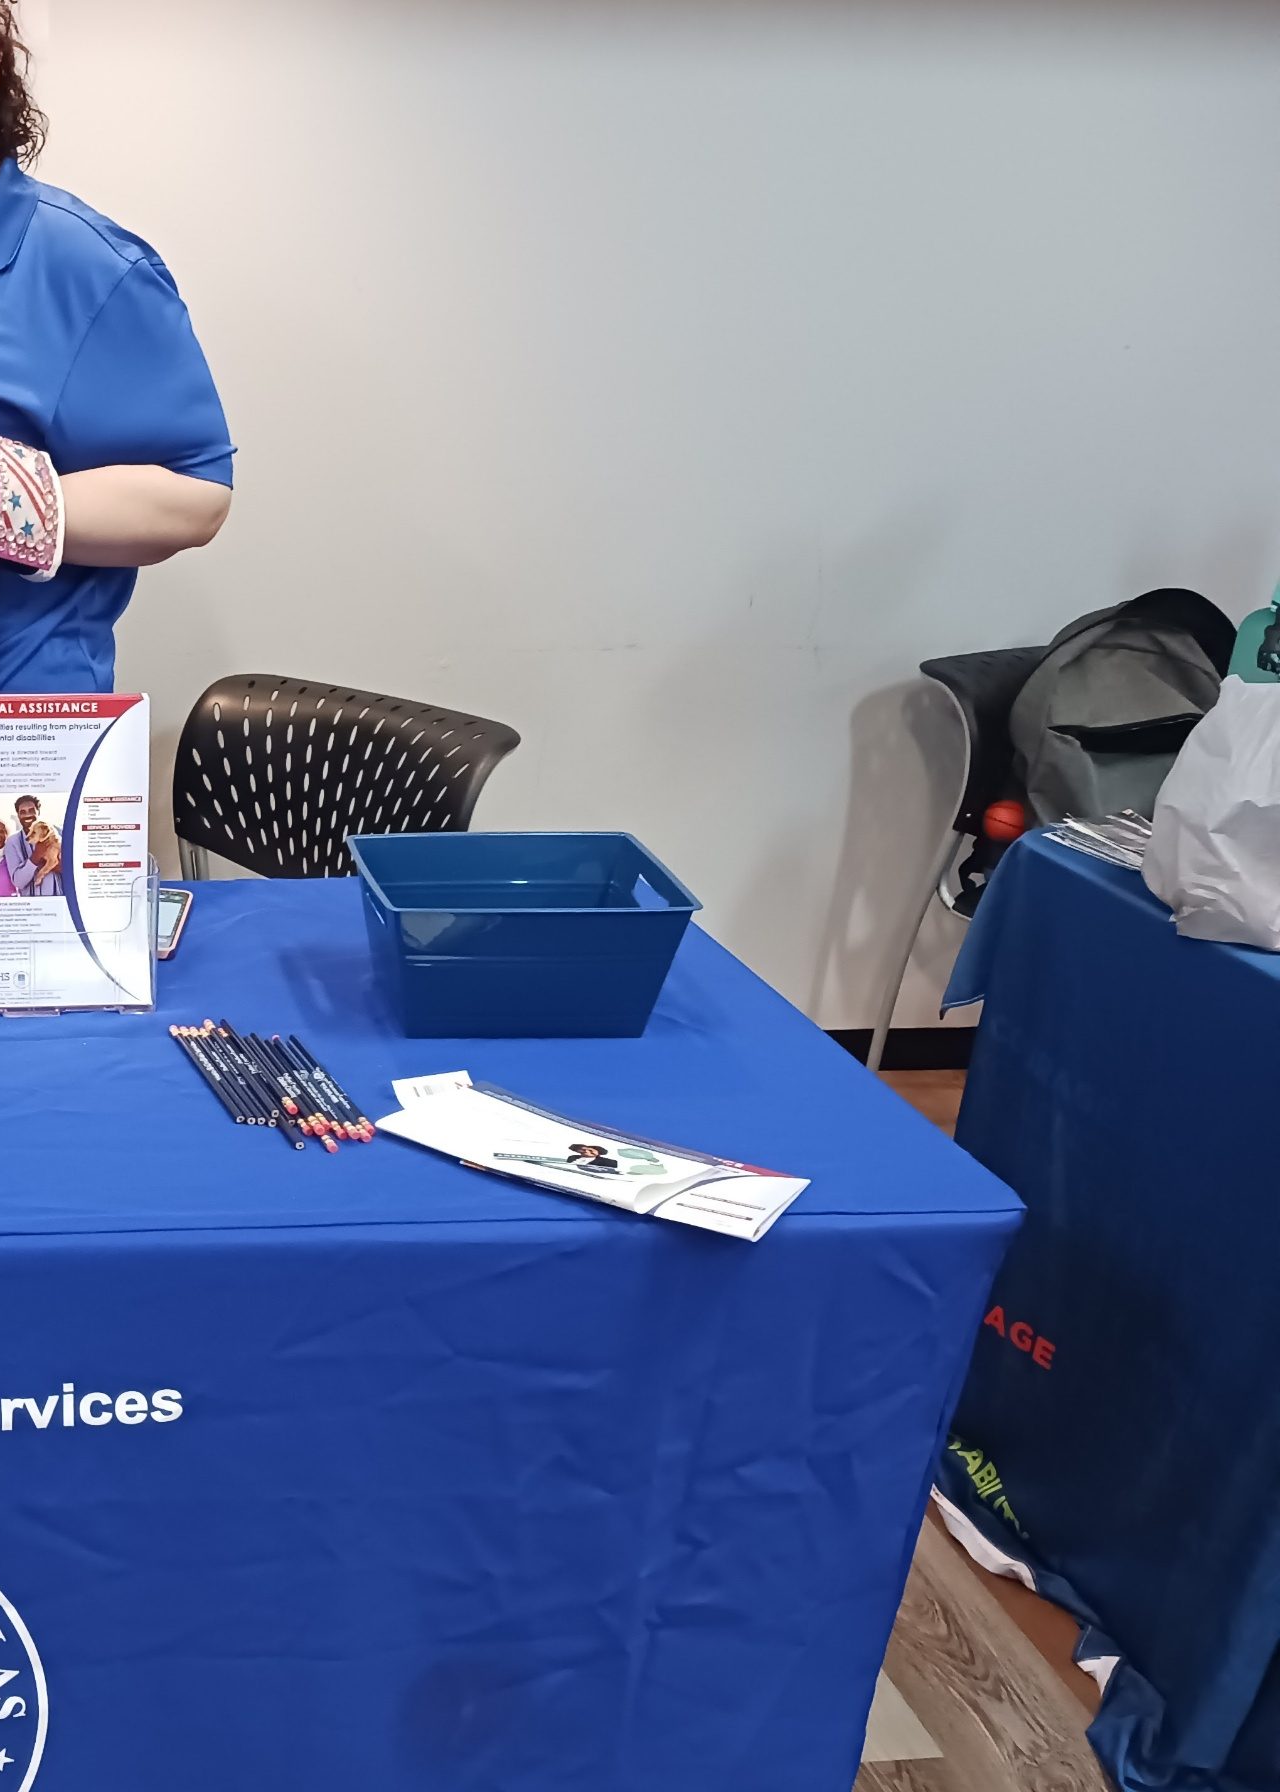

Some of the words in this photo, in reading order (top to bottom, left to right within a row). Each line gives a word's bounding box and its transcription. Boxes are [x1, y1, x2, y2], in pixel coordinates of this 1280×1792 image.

[18, 702, 98, 714] ASSISTANCE
[15, 723, 47, 732] resulting
[49, 723, 67, 731] from
[69, 722, 101, 732] physical
[16, 734, 56, 742] disabilities
[983, 1305, 1056, 1370] AGE
